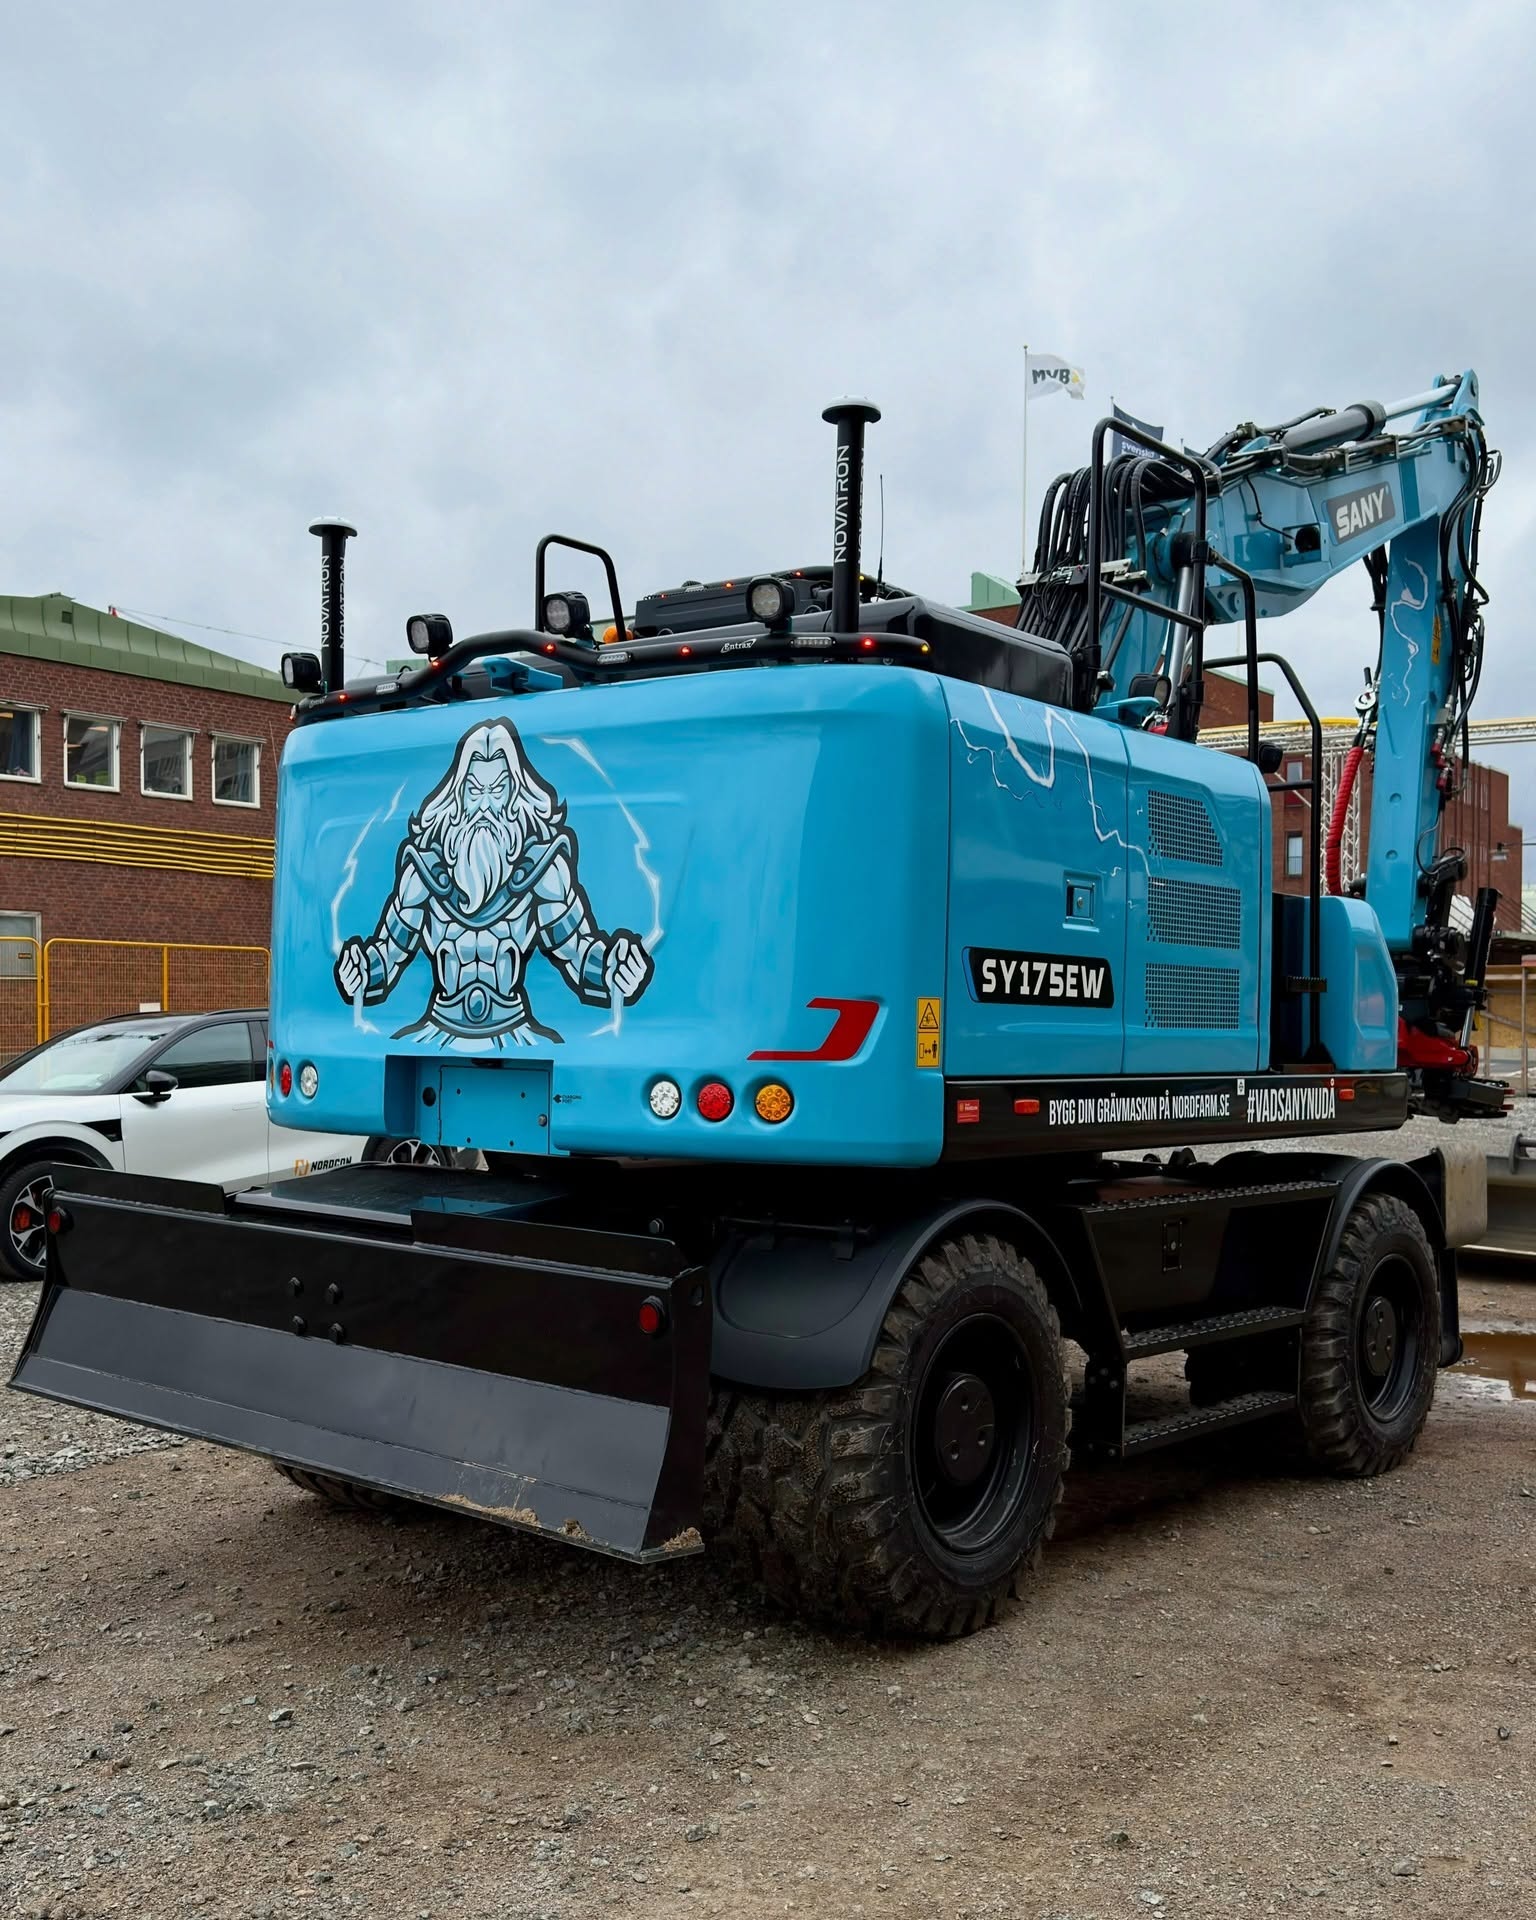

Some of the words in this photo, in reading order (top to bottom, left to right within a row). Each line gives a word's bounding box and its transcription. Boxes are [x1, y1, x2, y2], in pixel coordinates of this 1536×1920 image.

[1032, 368, 1071, 385] MVB
[833, 444, 850, 564] NOVATRON
[1336, 487, 1385, 539] SANY
[321, 555, 330, 648] NOVATRON
[723, 640, 753, 651] Entrax
[982, 958, 1105, 999] SY175EW
[1049, 1099, 1076, 1125] BYGG
[1078, 1098, 1095, 1124] DIN
[1097, 1092, 1157, 1123] GRÄVMASKIN
[1159, 1089, 1171, 1120] PÅ
[1172, 1093, 1230, 1119] NORDFARM.SE
[1247, 1077, 1336, 1124] #VADSANYNUDÅ
